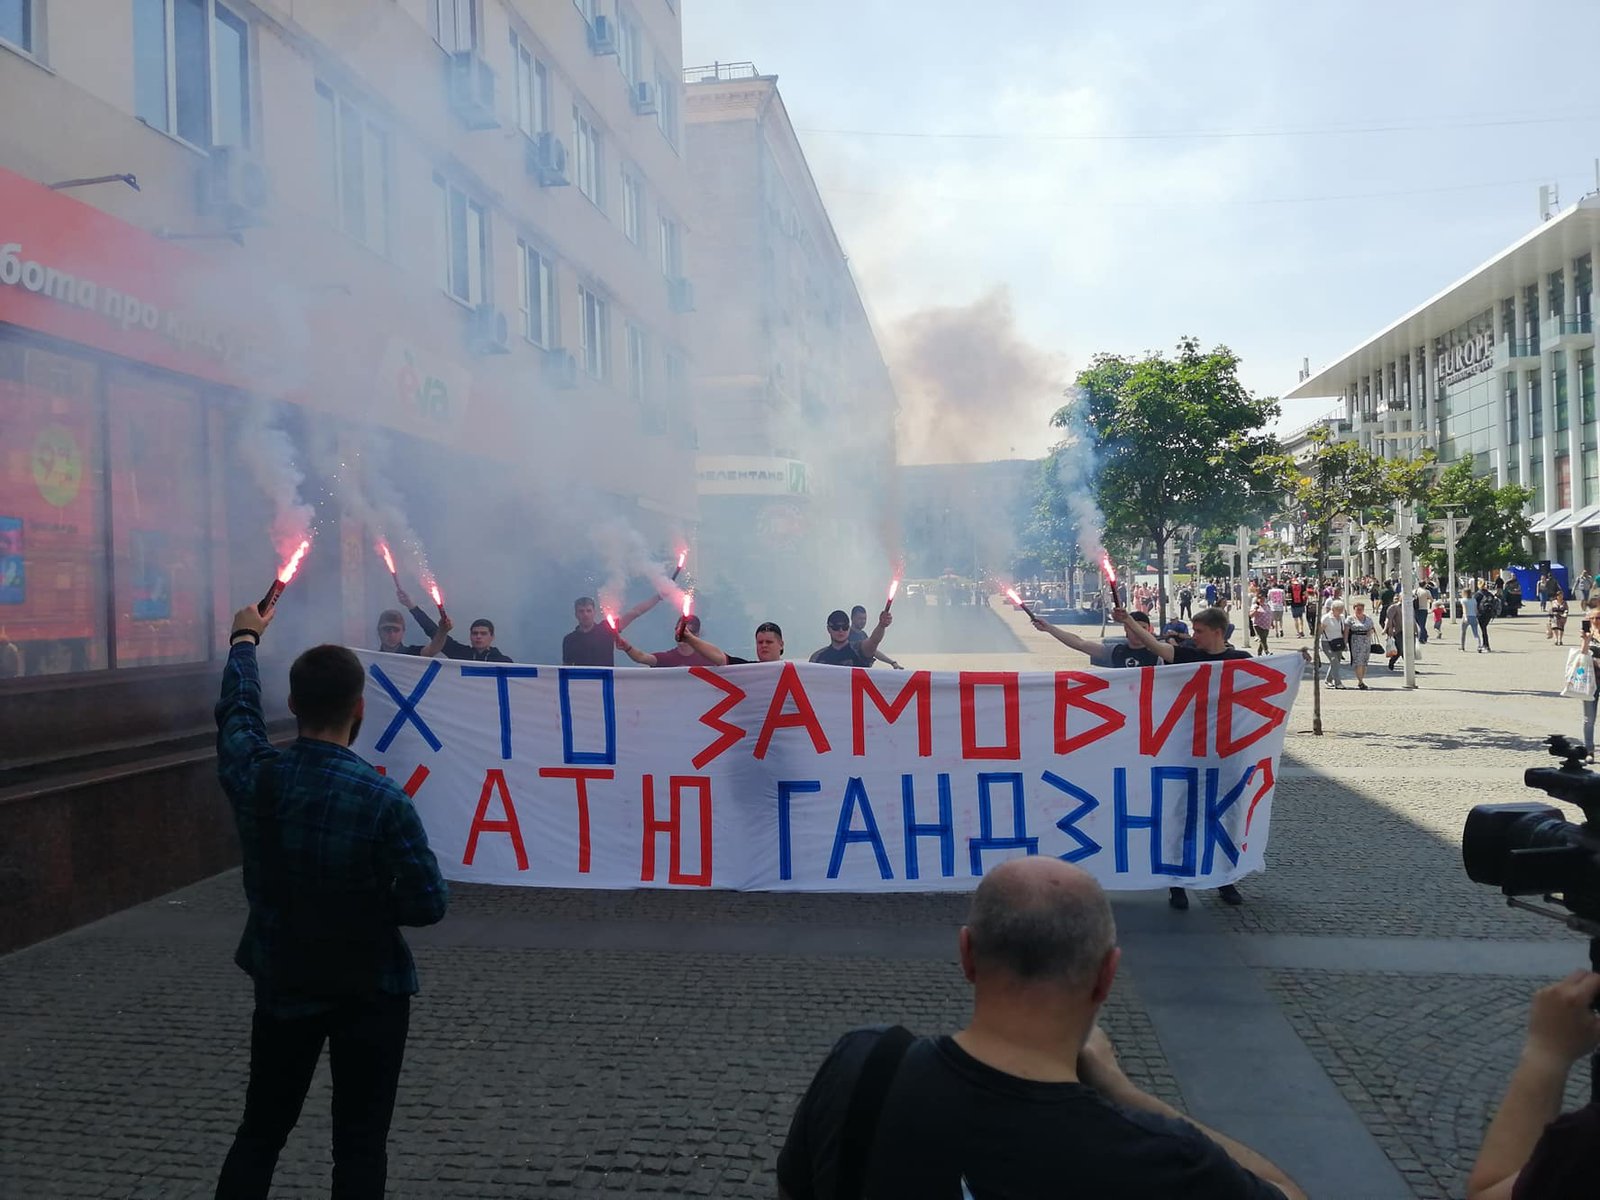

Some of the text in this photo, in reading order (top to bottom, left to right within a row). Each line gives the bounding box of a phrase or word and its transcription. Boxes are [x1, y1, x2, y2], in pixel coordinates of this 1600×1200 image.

[104, 287, 159, 330] про
[1438, 331, 1493, 378] EUROPE
[369, 659, 1288, 770] ХТО ЗАМОВИВ
[776, 757, 1275, 887] ГАНДЗЮК?
